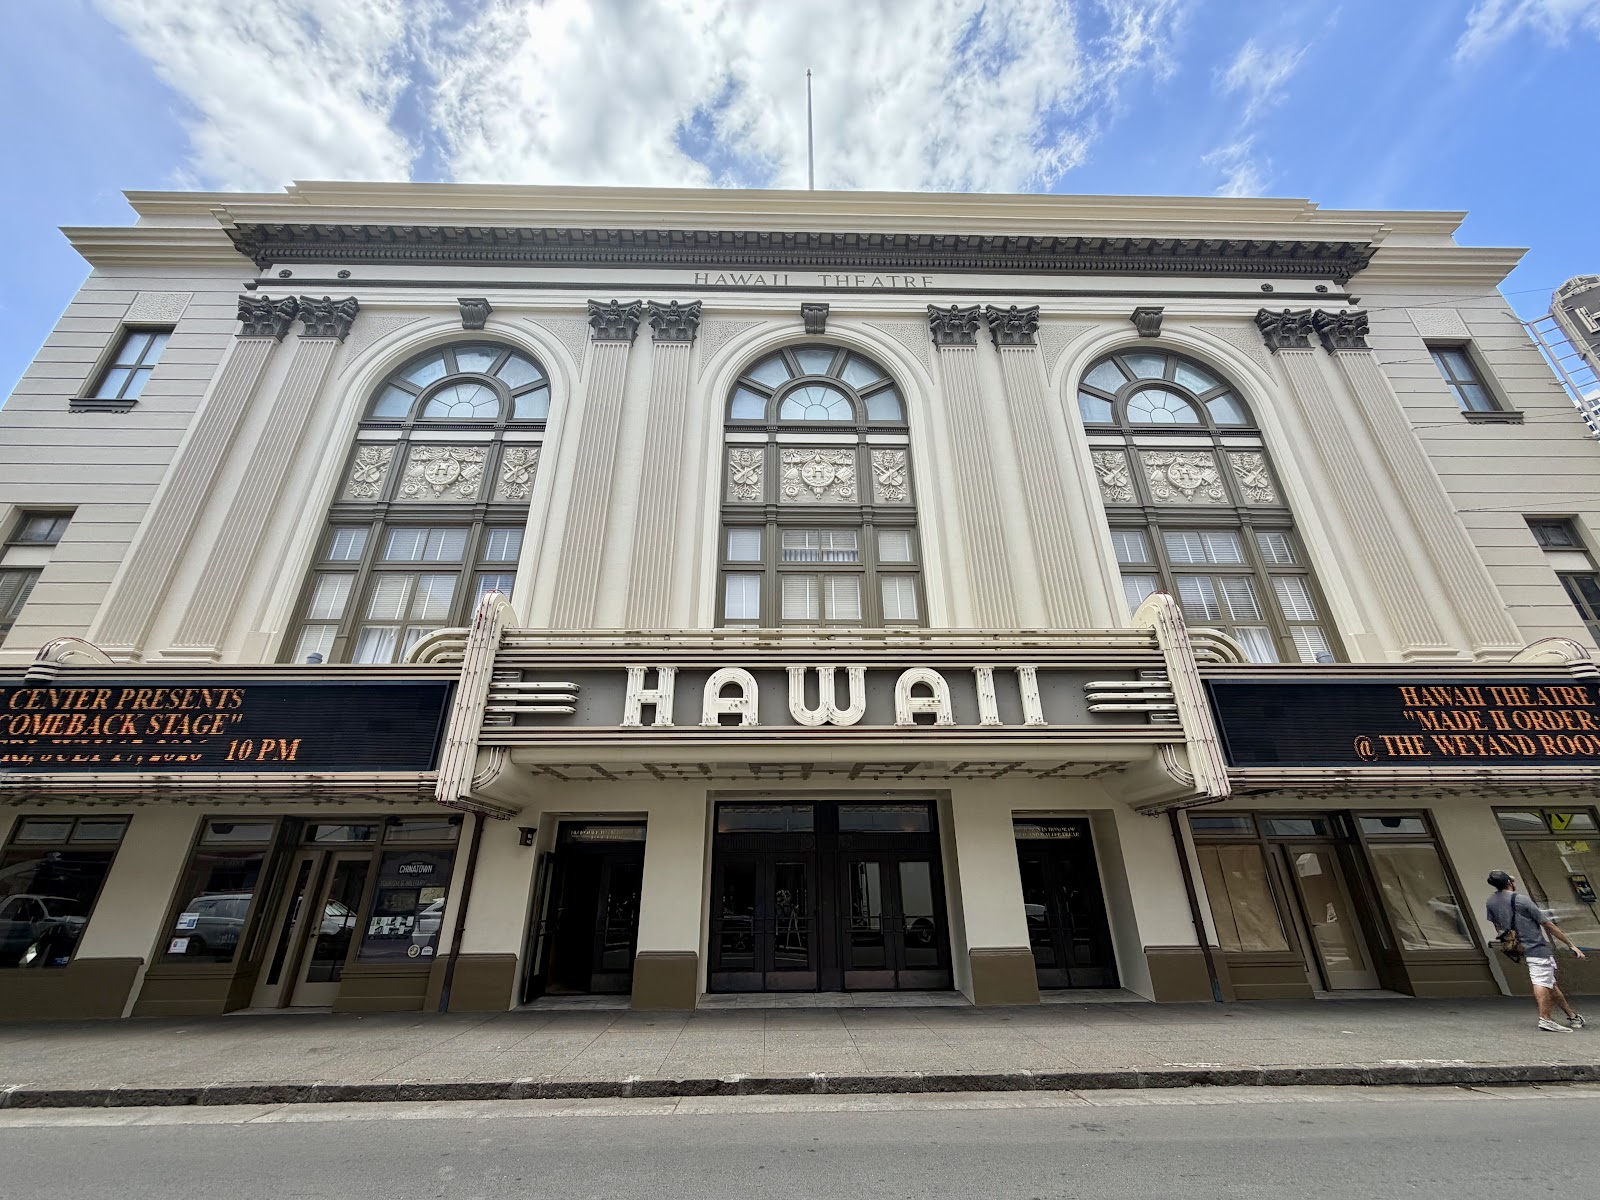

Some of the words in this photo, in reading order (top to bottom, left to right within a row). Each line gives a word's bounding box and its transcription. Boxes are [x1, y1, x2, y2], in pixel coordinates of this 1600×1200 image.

[693, 272, 790, 286] HAWAII
[817, 273, 934, 288] THEATRE
[9, 688, 112, 710] CENTER
[114, 688, 247, 710] PRESENTS
[619, 665, 1049, 728] HAWAII
[1398, 686, 1487, 706] HAWAII
[1485, 686, 1596, 706] THEATRE
[145, 713, 244, 736] STAGE"
[1402, 710, 1489, 731] "MADE
[224, 738, 254, 762] 10
[255, 738, 302, 762] PM
[1353, 734, 1379, 762] @
[1378, 734, 1432, 756] THE
[1430, 734, 1537, 756] WEYAND
[399, 865, 433, 873] CHINATOWN
